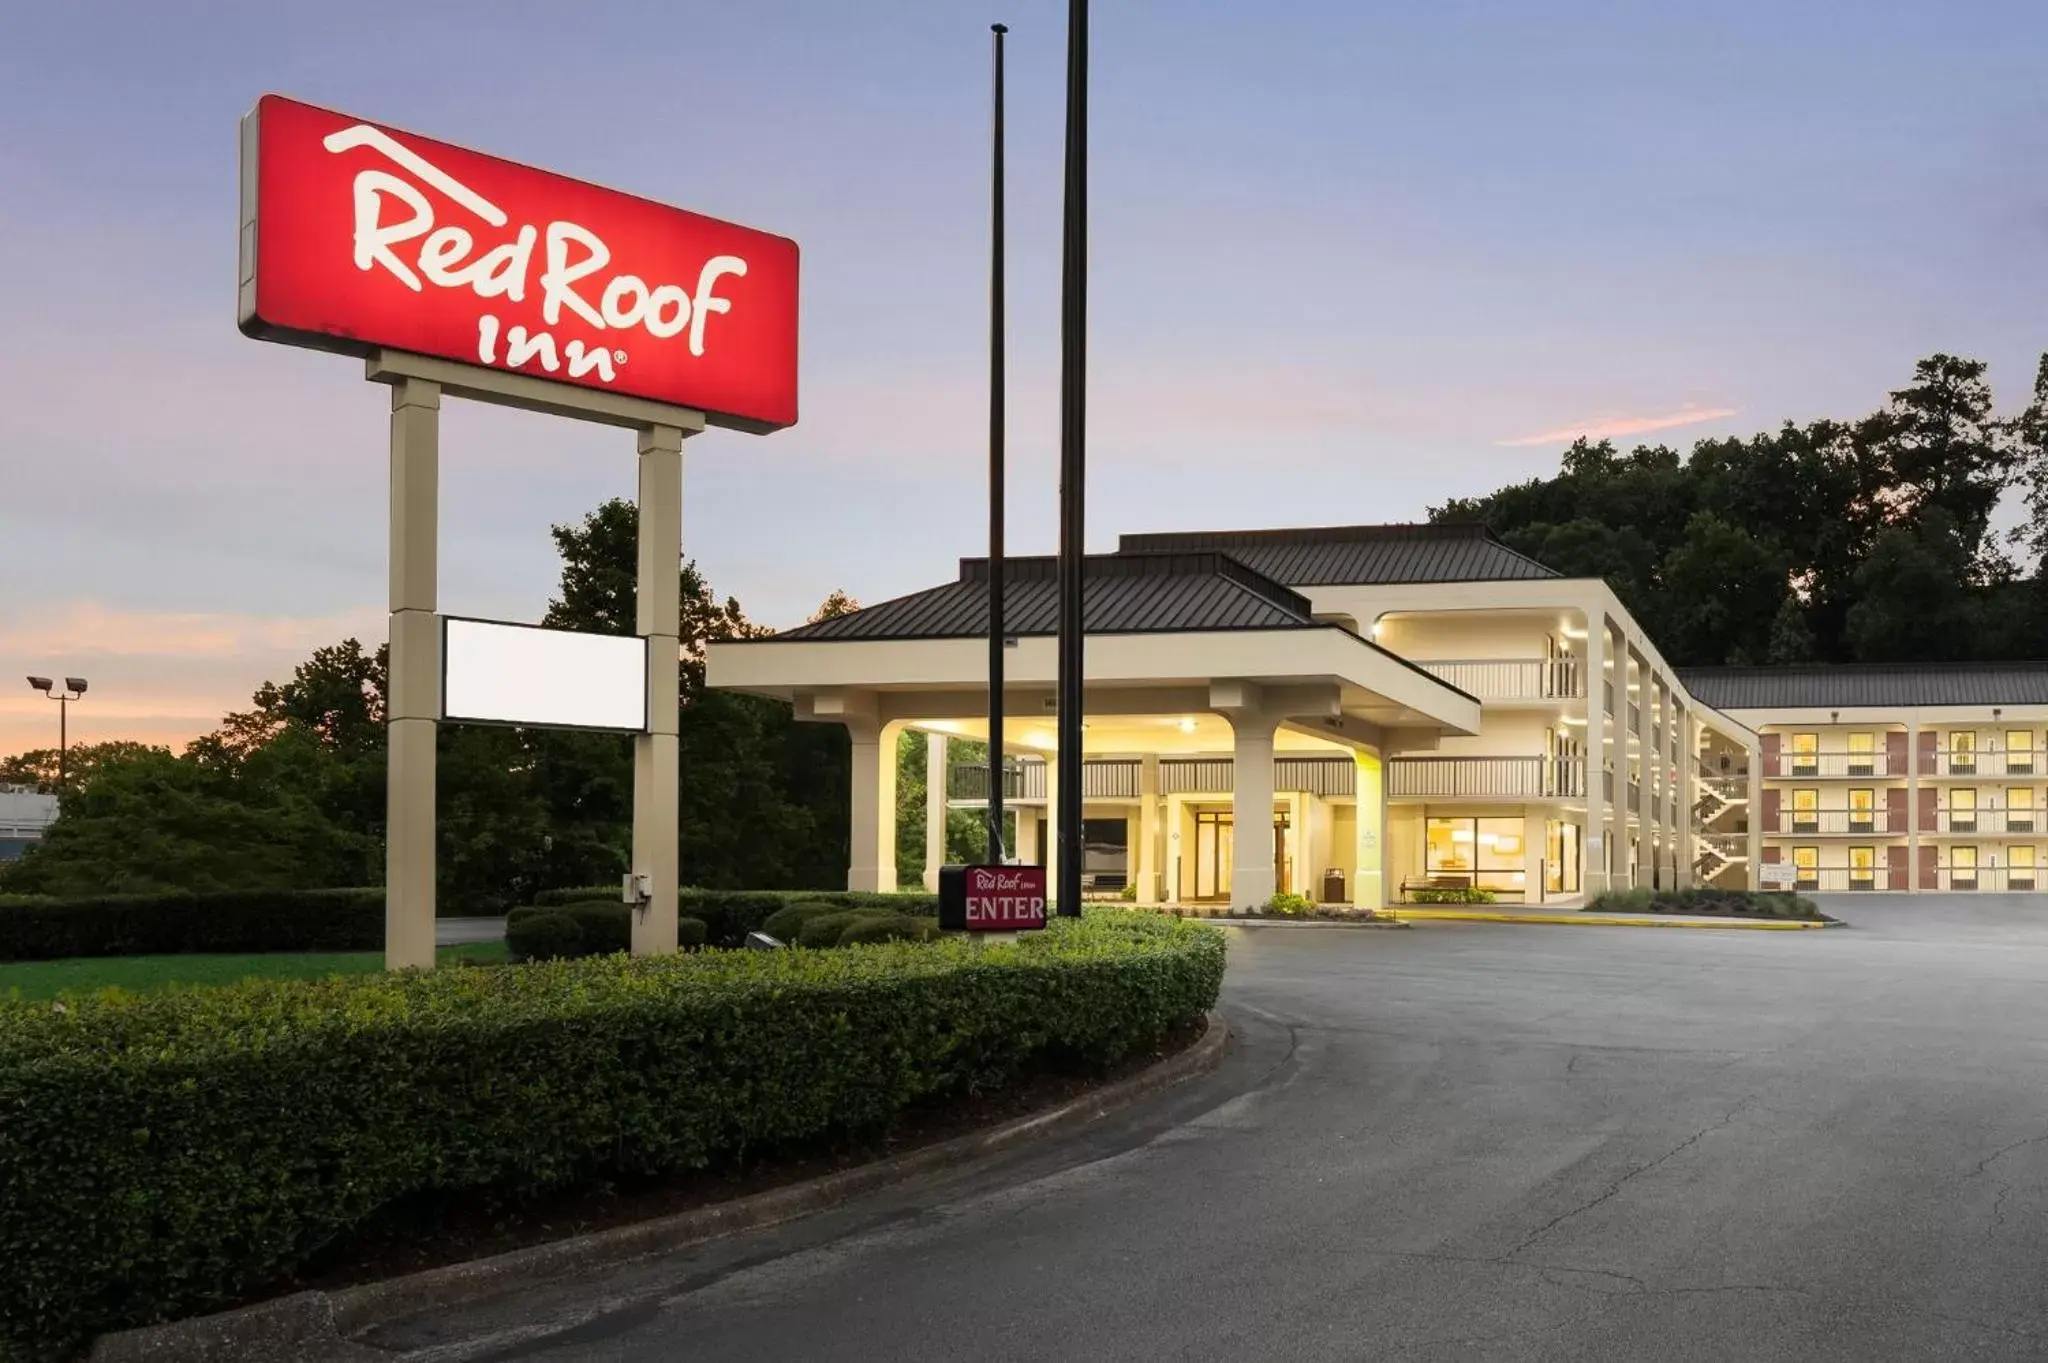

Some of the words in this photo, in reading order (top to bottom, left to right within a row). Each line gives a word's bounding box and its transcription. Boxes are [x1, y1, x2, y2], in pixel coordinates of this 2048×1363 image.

[353, 170, 538, 302] Red
[540, 221, 748, 357] Roof
[976, 874, 996, 891] Red
[997, 873, 1022, 891] Roof
[966, 896, 1045, 920] ENTER
